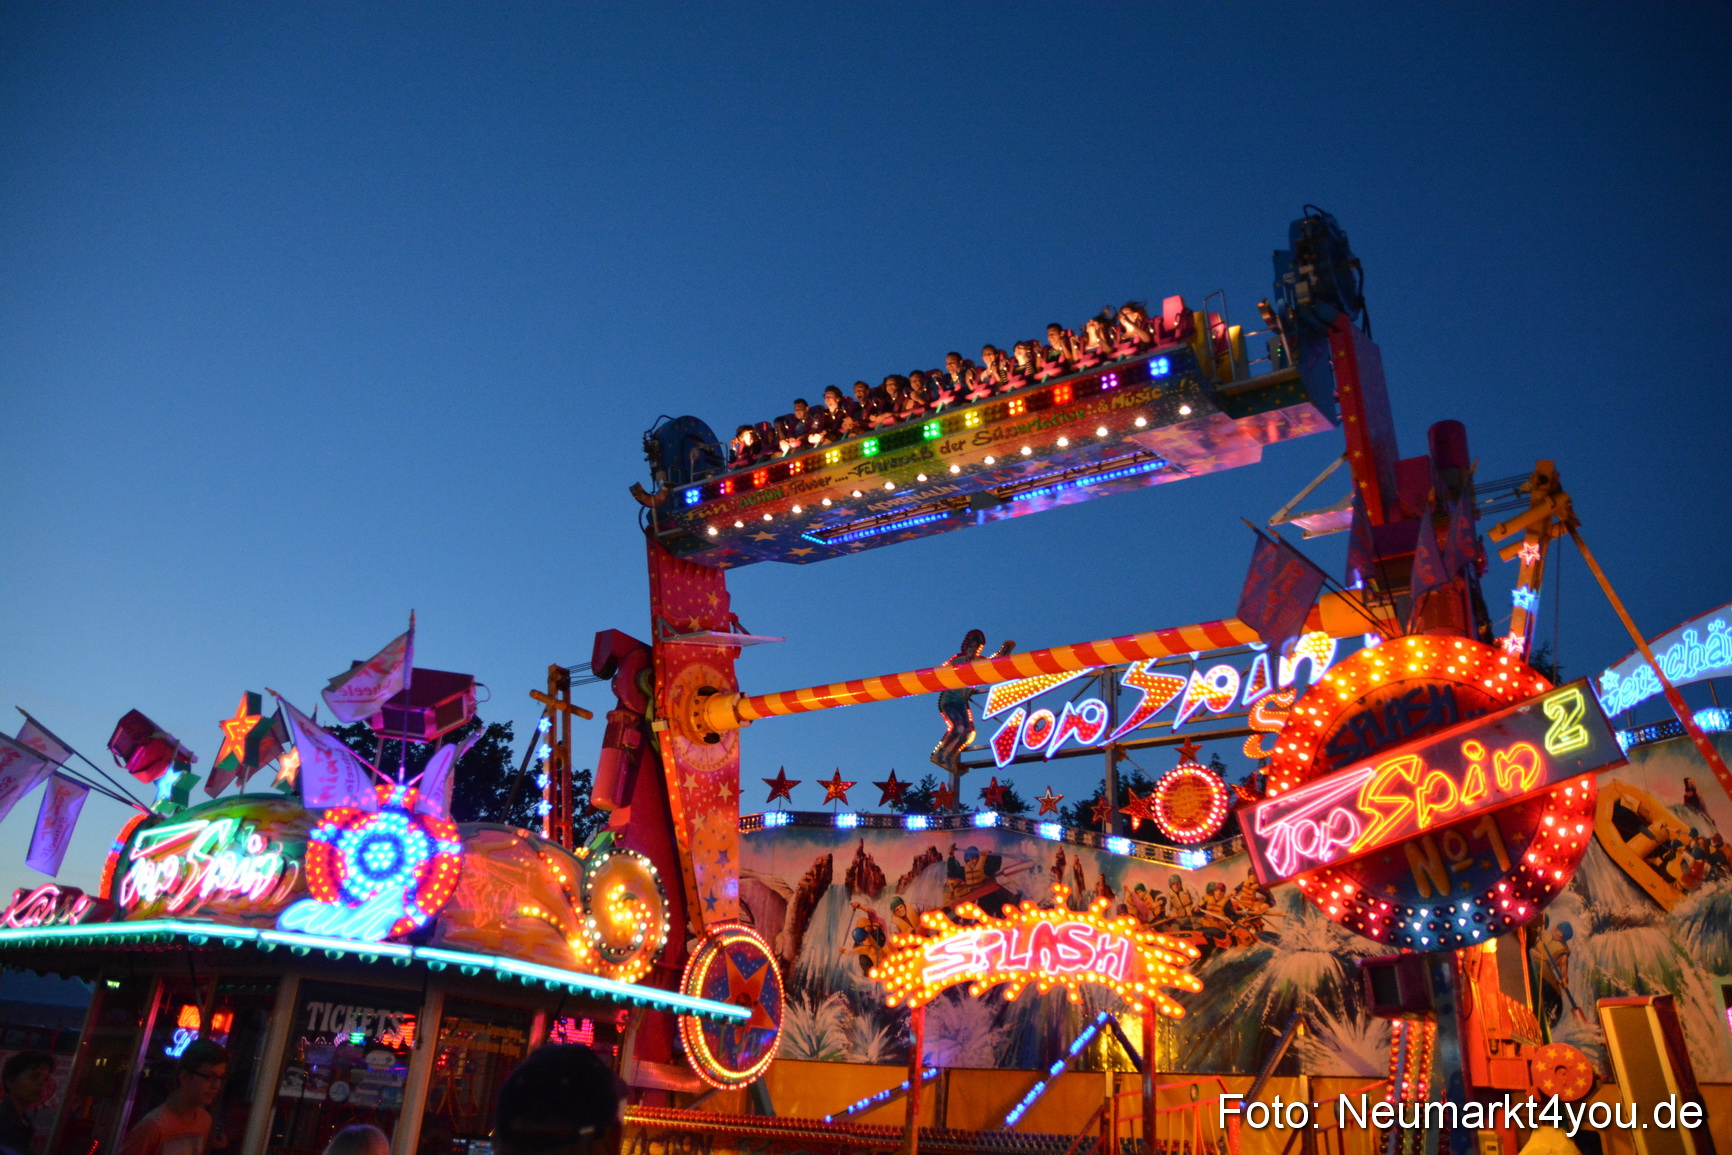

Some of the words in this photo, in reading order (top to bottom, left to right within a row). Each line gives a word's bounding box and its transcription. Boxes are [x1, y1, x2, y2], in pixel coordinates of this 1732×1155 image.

[939, 439, 966, 455] der
[866, 484, 962, 512] ADRENALIN
[982, 666, 1108, 769] Top
[1097, 630, 1338, 747] Spin
[1326, 684, 1458, 771] SPLASH
[1255, 767, 1375, 877] Top
[1349, 740, 1542, 853] Spin
[1543, 688, 1588, 756] 2
[923, 921, 1128, 983] SPLASH
[306, 1000, 405, 1038] TICKETS
